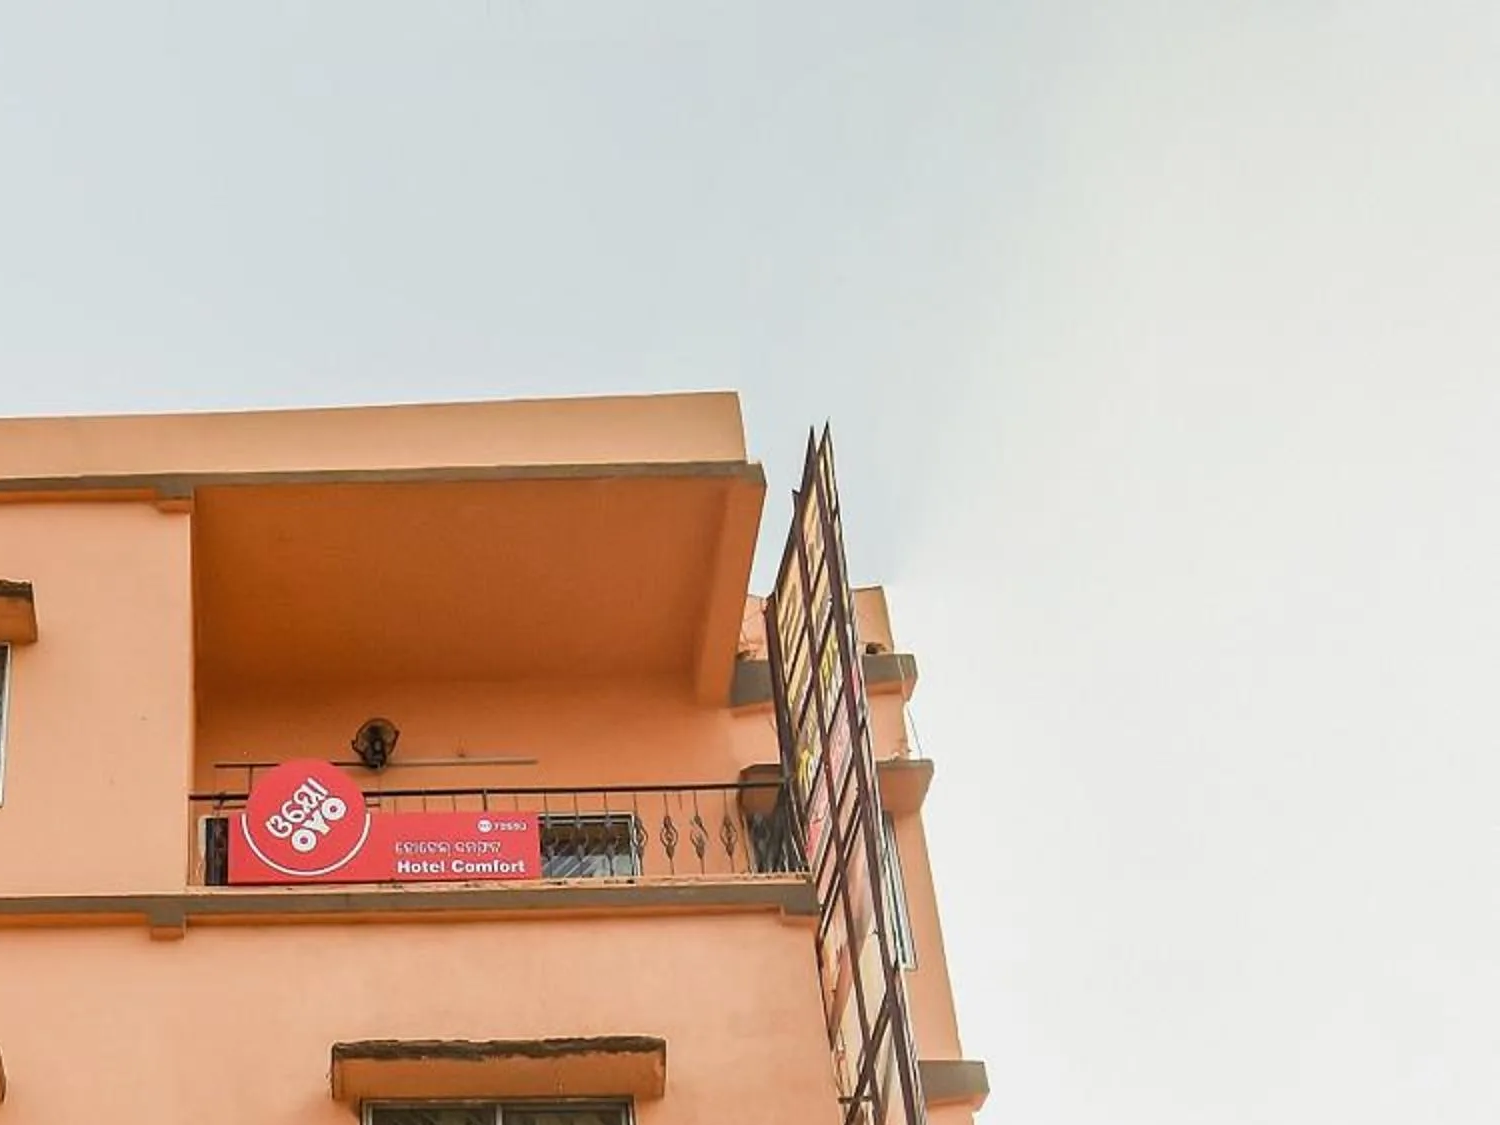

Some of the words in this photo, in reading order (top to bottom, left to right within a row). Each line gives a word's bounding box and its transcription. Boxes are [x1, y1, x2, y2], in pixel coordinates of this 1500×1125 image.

[291, 797, 347, 852] OYO
[397, 859, 445, 873] Hotel
[451, 859, 526, 873] Comfort
